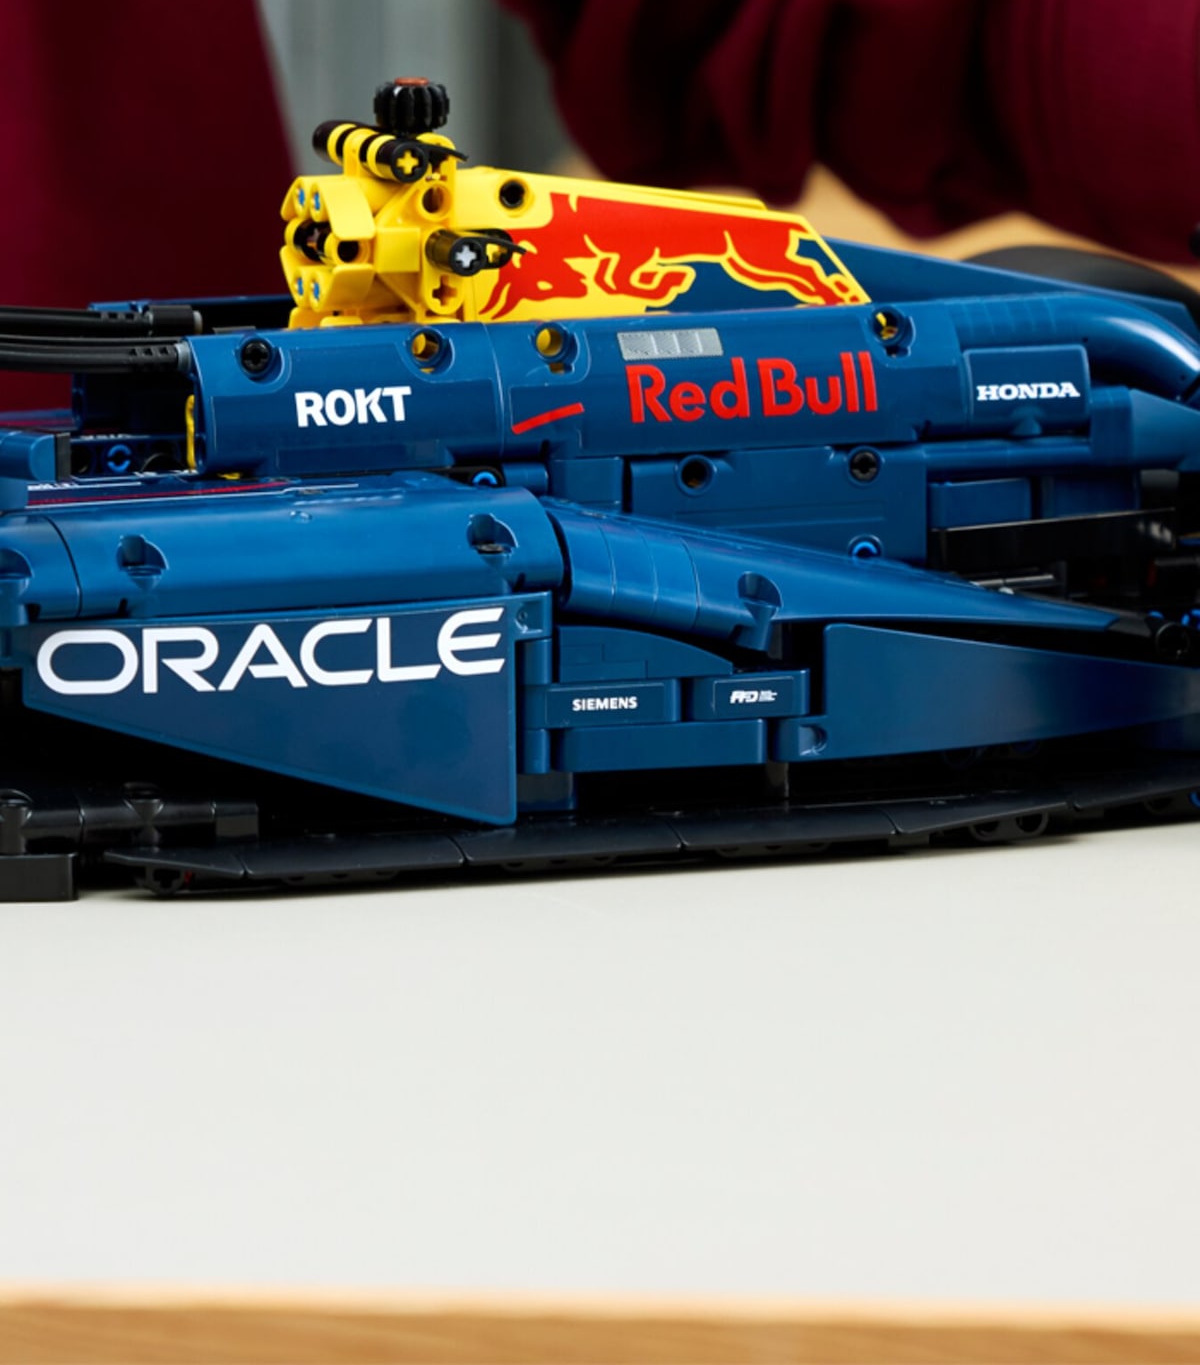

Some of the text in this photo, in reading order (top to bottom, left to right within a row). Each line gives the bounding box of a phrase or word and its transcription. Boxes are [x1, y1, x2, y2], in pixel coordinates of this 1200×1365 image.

[294, 385, 412, 428] ROKT
[625, 351, 878, 424] Red Bull
[976, 381, 1081, 402] HONDA
[36, 607, 506, 696] ORACLE
[571, 696, 638, 712] SIEMENS
